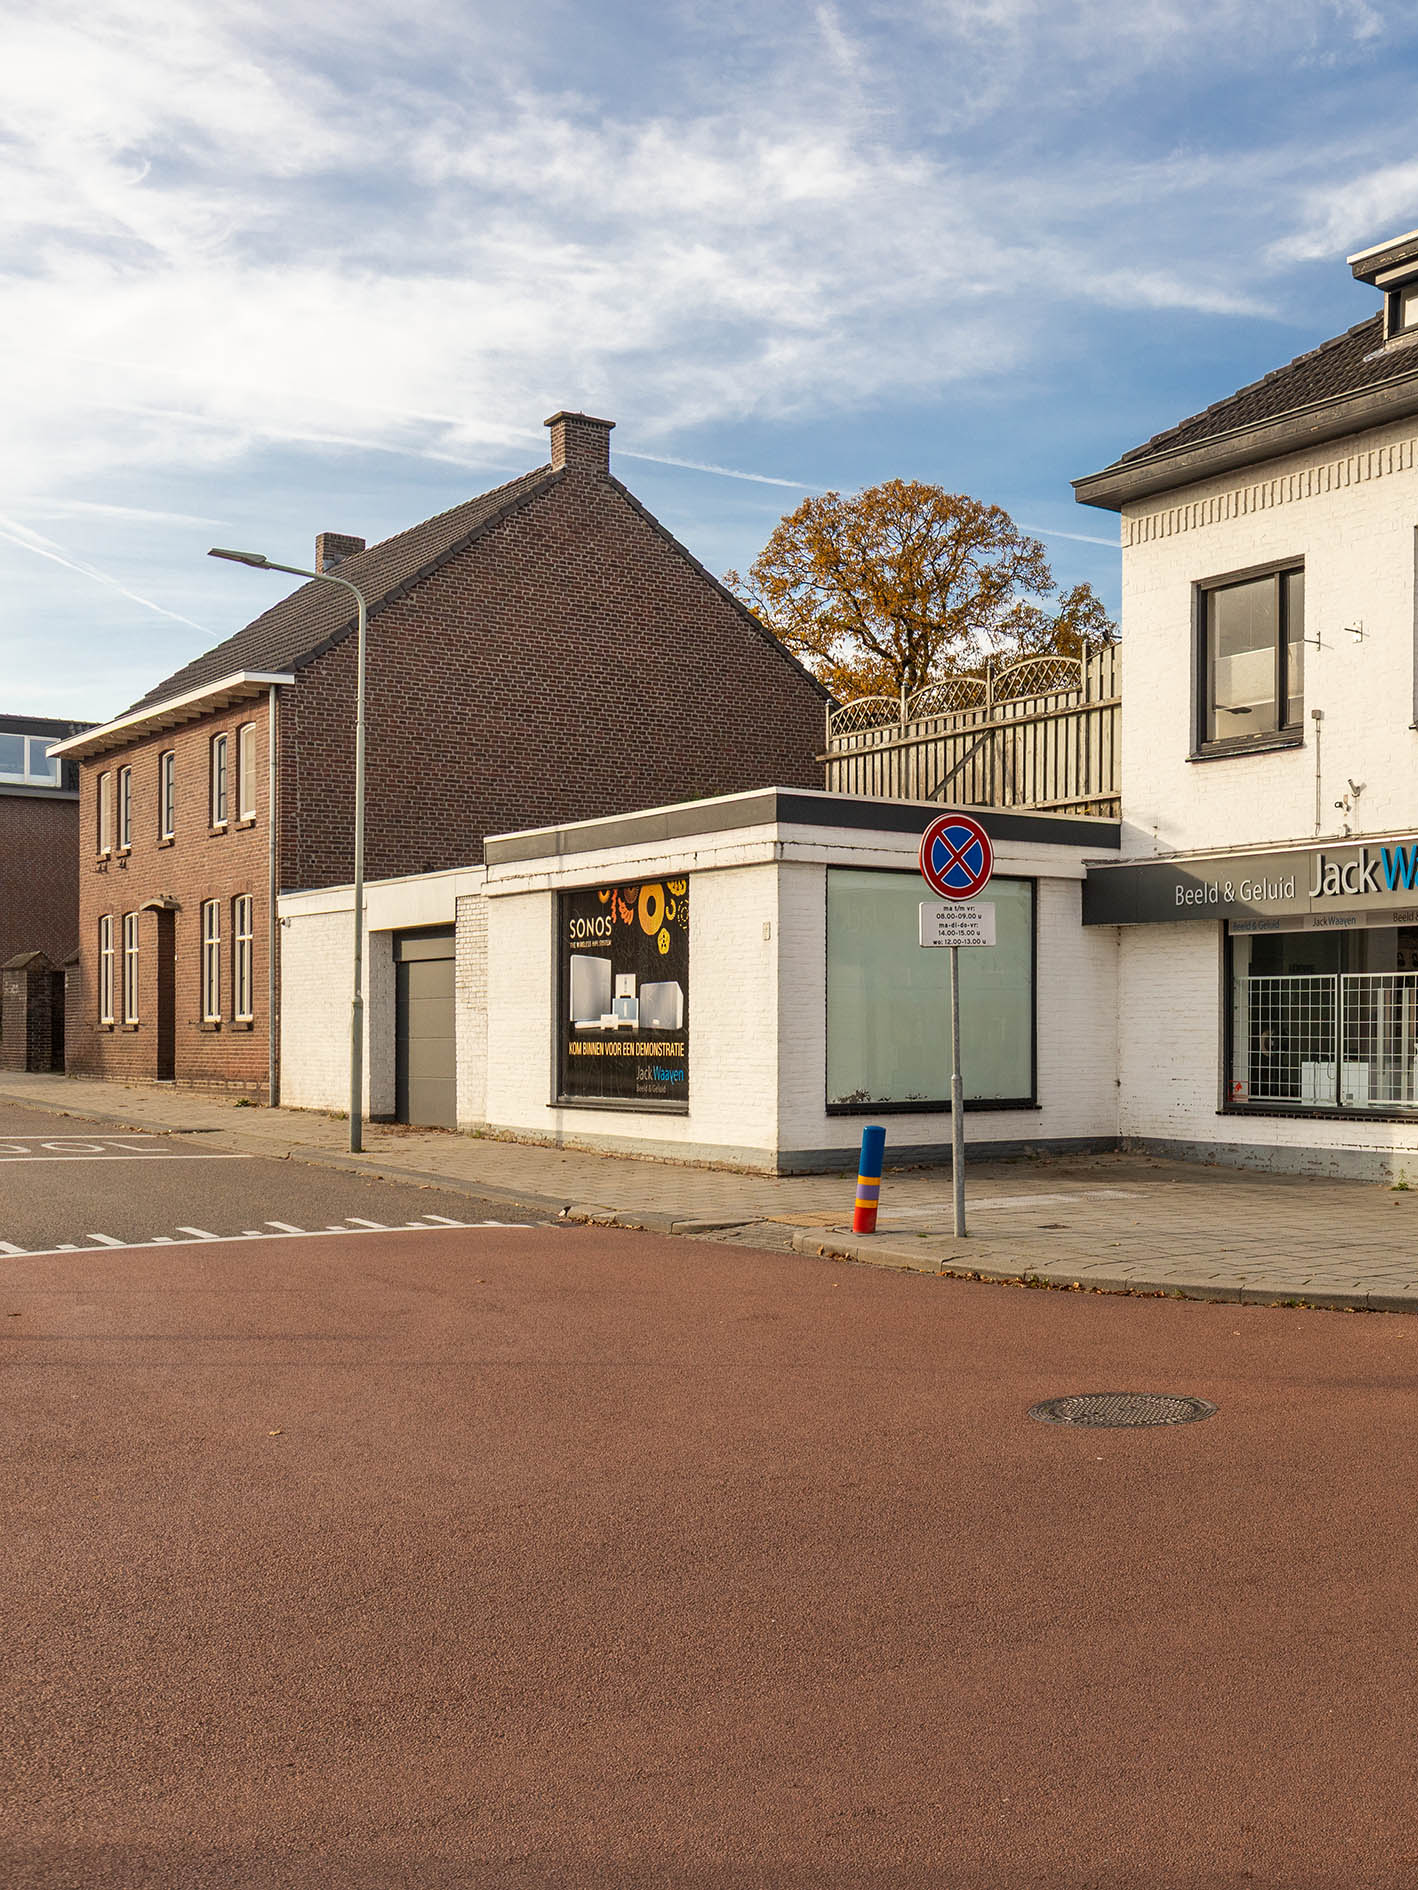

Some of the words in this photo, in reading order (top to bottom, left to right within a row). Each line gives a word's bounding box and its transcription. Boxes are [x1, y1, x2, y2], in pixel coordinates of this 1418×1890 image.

[1175, 882, 1218, 905] Beeld
[1223, 880, 1236, 901] &
[1239, 876, 1296, 902] Geluid
[1309, 847, 1379, 897] Jack
[1393, 911, 1413, 922] Beeld
[569, 915, 612, 939] SONOS
[569, 1041, 582, 1055] KOM
[582, 1041, 604, 1056] BINNEN
[605, 1041, 622, 1056] VOOR
[623, 1042, 635, 1056] EEN
[635, 1042, 685, 1057] DEMONSTRATIE
[636, 1066, 653, 1081] Jack
